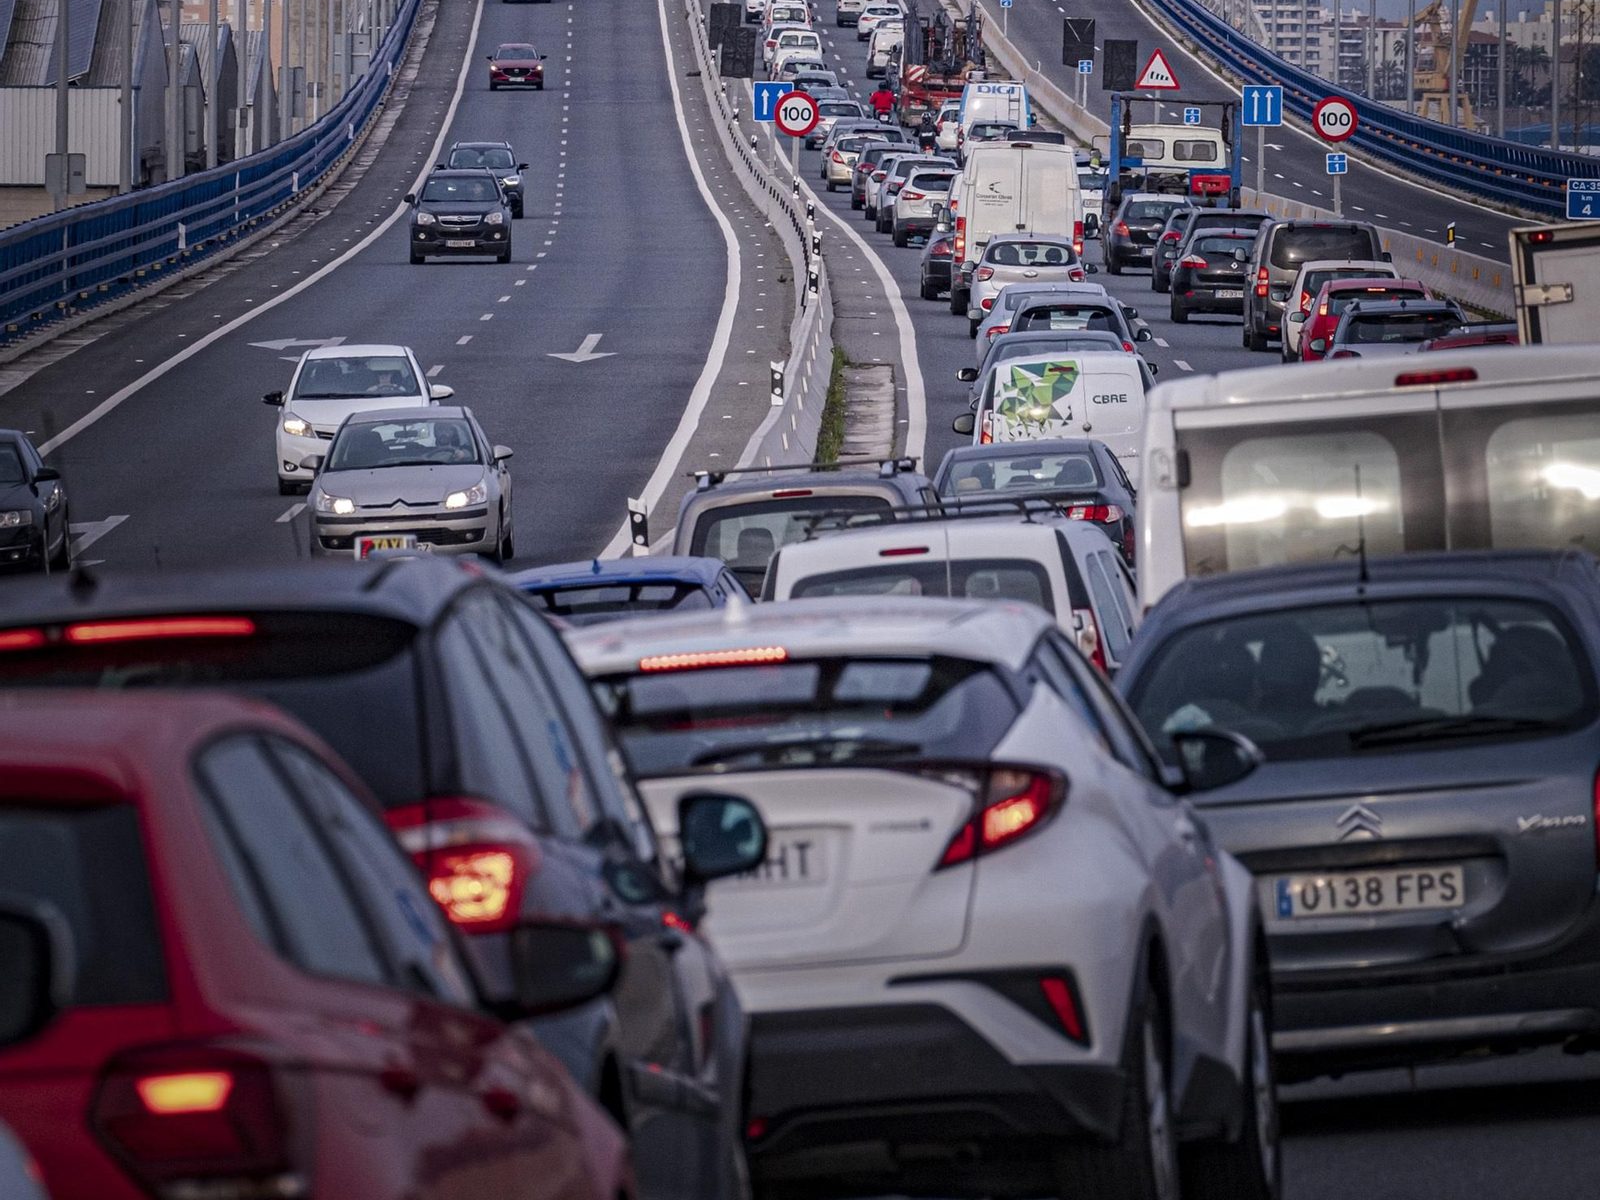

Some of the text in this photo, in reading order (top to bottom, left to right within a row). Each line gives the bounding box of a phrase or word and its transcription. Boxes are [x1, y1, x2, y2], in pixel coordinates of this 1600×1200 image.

[977, 85, 1015, 94] DIGI
[782, 106, 812, 121] 100
[1321, 112, 1351, 126] 100
[1582, 203, 1592, 215] 4
[1092, 394, 1128, 404] CBRE
[1299, 871, 1458, 911] 0138 FPS
